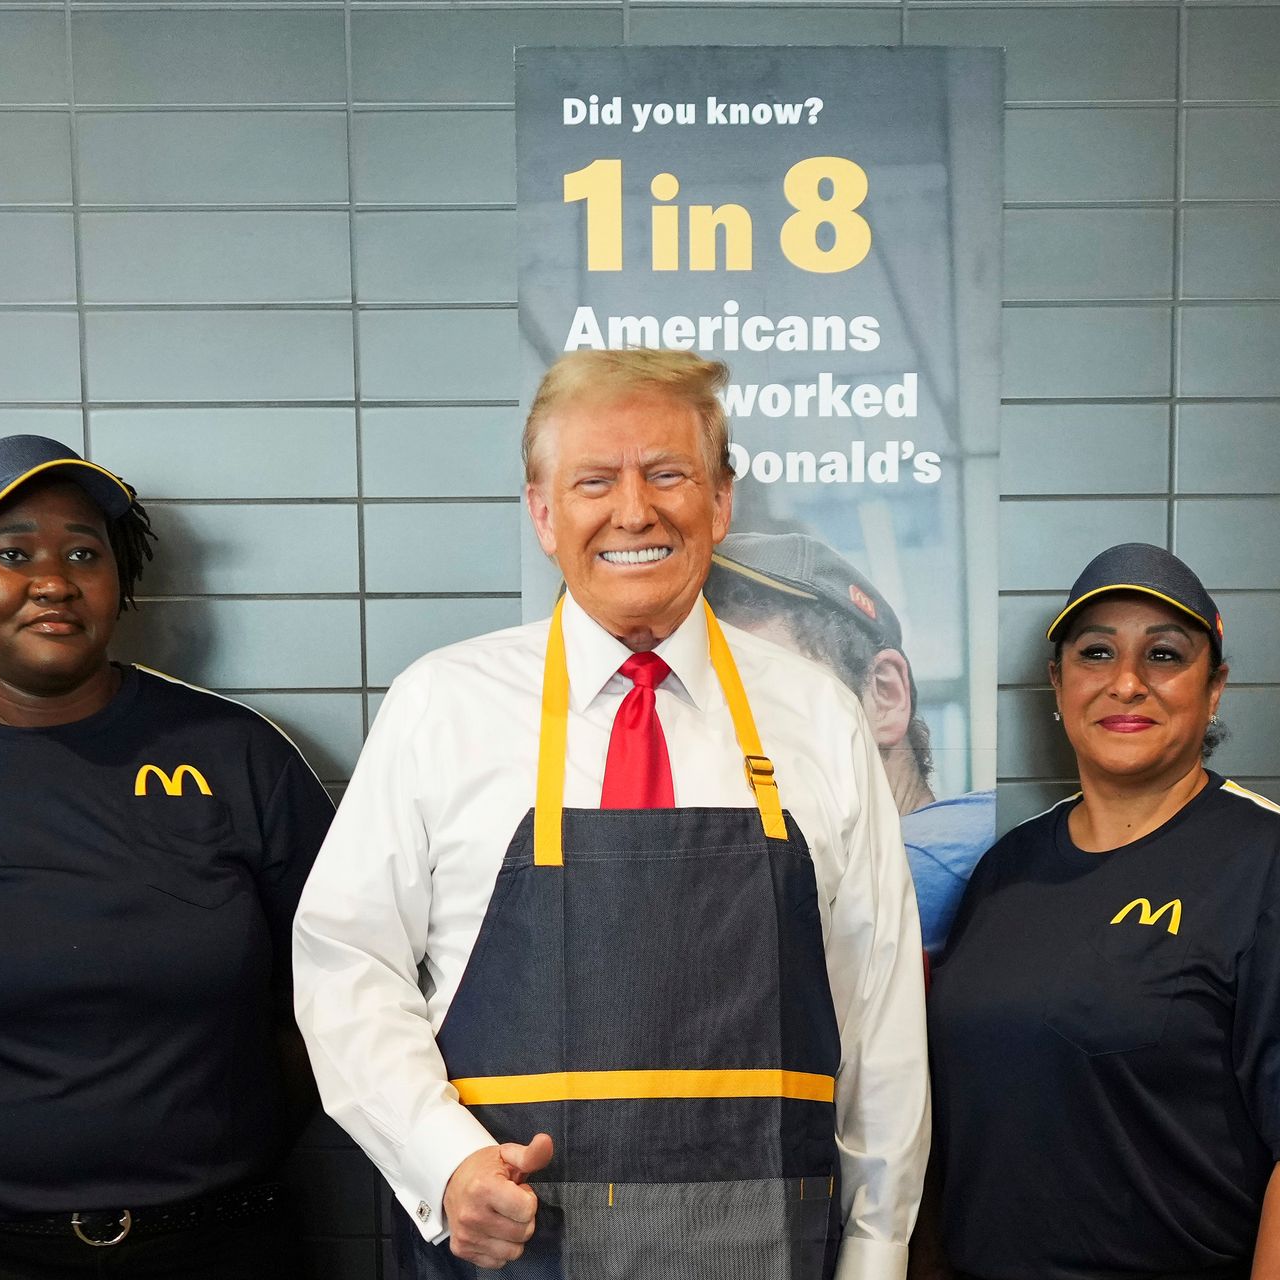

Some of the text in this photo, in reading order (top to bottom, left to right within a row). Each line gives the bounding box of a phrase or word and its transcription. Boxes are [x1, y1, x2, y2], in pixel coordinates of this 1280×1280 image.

[563, 94, 824, 132] Did you know?
[564, 156, 872, 273] 1 in 8
[564, 299, 881, 352] Americans
[720, 372, 918, 418] worked
[728, 440, 942, 484] Donald's
